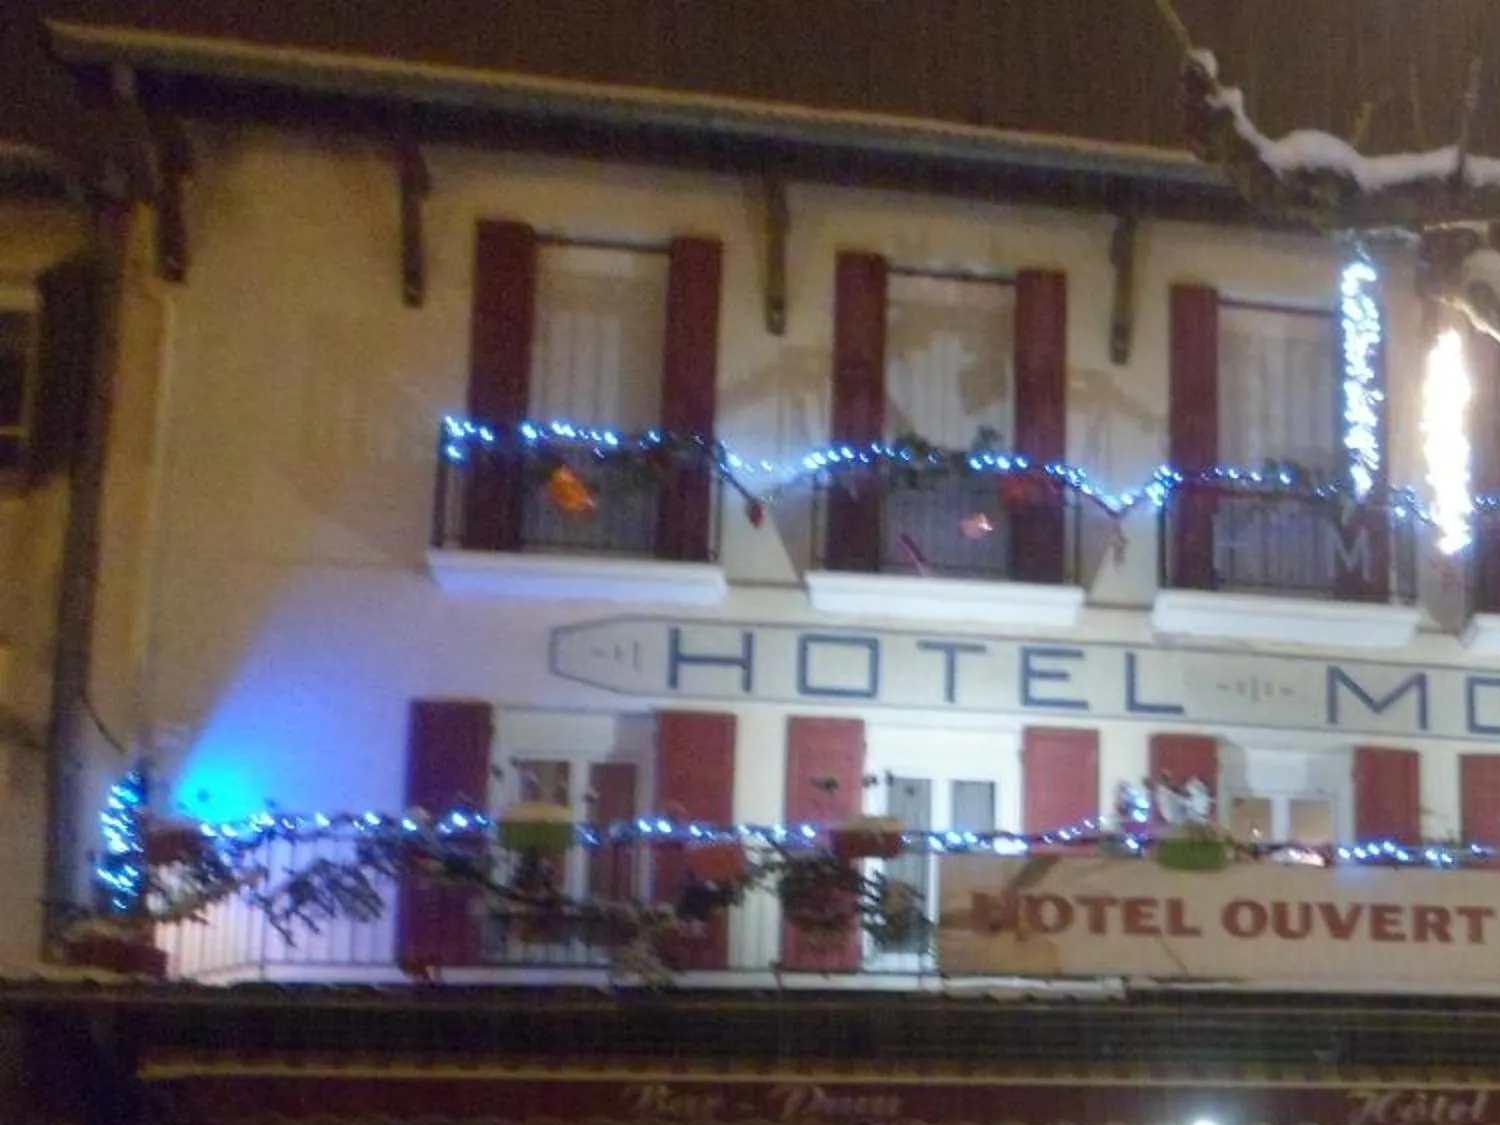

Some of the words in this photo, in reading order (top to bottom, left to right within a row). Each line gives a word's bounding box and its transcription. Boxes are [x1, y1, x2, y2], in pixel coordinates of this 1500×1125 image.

[667, 626, 1185, 715] HOTEL
[970, 891, 1202, 941] HOTEL
[1220, 899, 1494, 944] OUVERT
